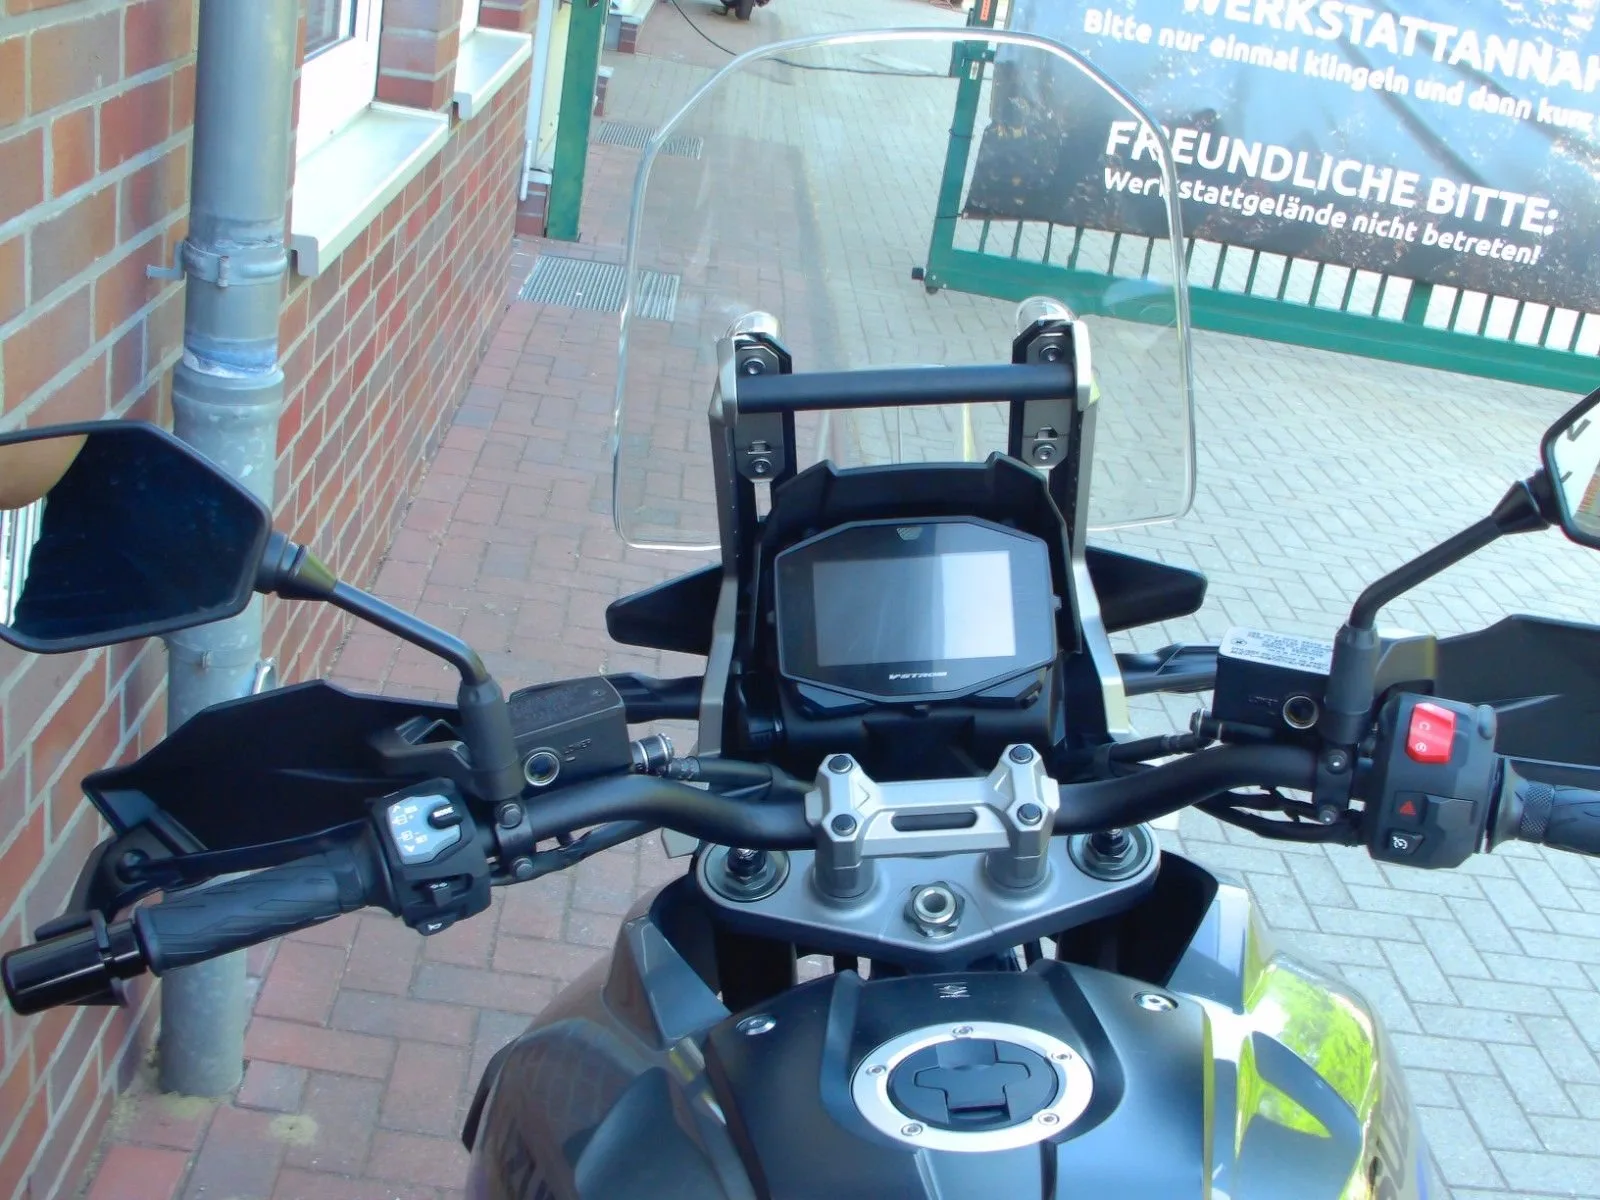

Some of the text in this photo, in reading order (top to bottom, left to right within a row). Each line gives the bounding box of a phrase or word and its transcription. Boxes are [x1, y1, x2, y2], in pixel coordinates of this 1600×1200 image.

[1084, 8, 1595, 134] Bitte nur einmal klingeln und dann kurz
[1426, 177, 1559, 235] BITTE:
[1352, 212, 1418, 242] nicht
[1421, 222, 1542, 266] betreten!
